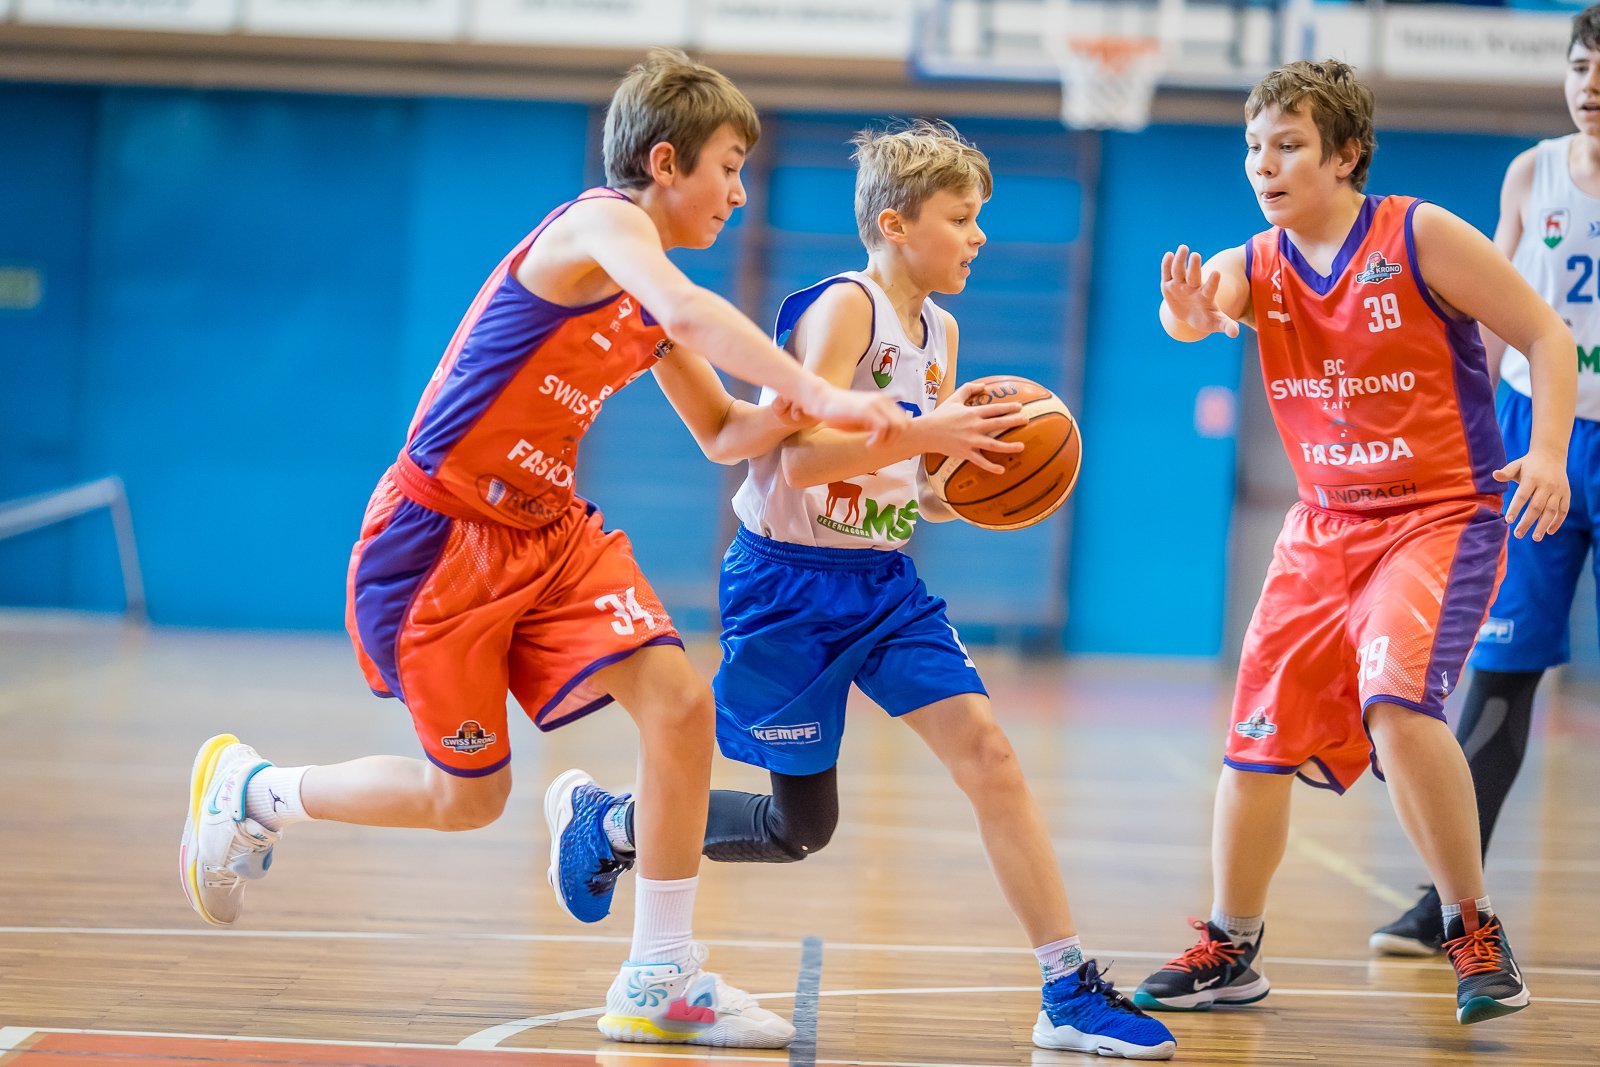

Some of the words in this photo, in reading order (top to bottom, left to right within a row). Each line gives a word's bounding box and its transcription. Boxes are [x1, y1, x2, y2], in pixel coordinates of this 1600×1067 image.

[1566, 255, 1600, 303] 2
[1364, 293, 1402, 333] 39
[1323, 359, 1345, 377] BC
[1271, 377, 1334, 400] SWISS
[1338, 371, 1416, 398] KRONO
[1300, 437, 1414, 466] FASADA
[1327, 482, 1417, 504] ANDRACH
[594, 586, 656, 636] 34
[753, 726, 817, 741] KEMPF
